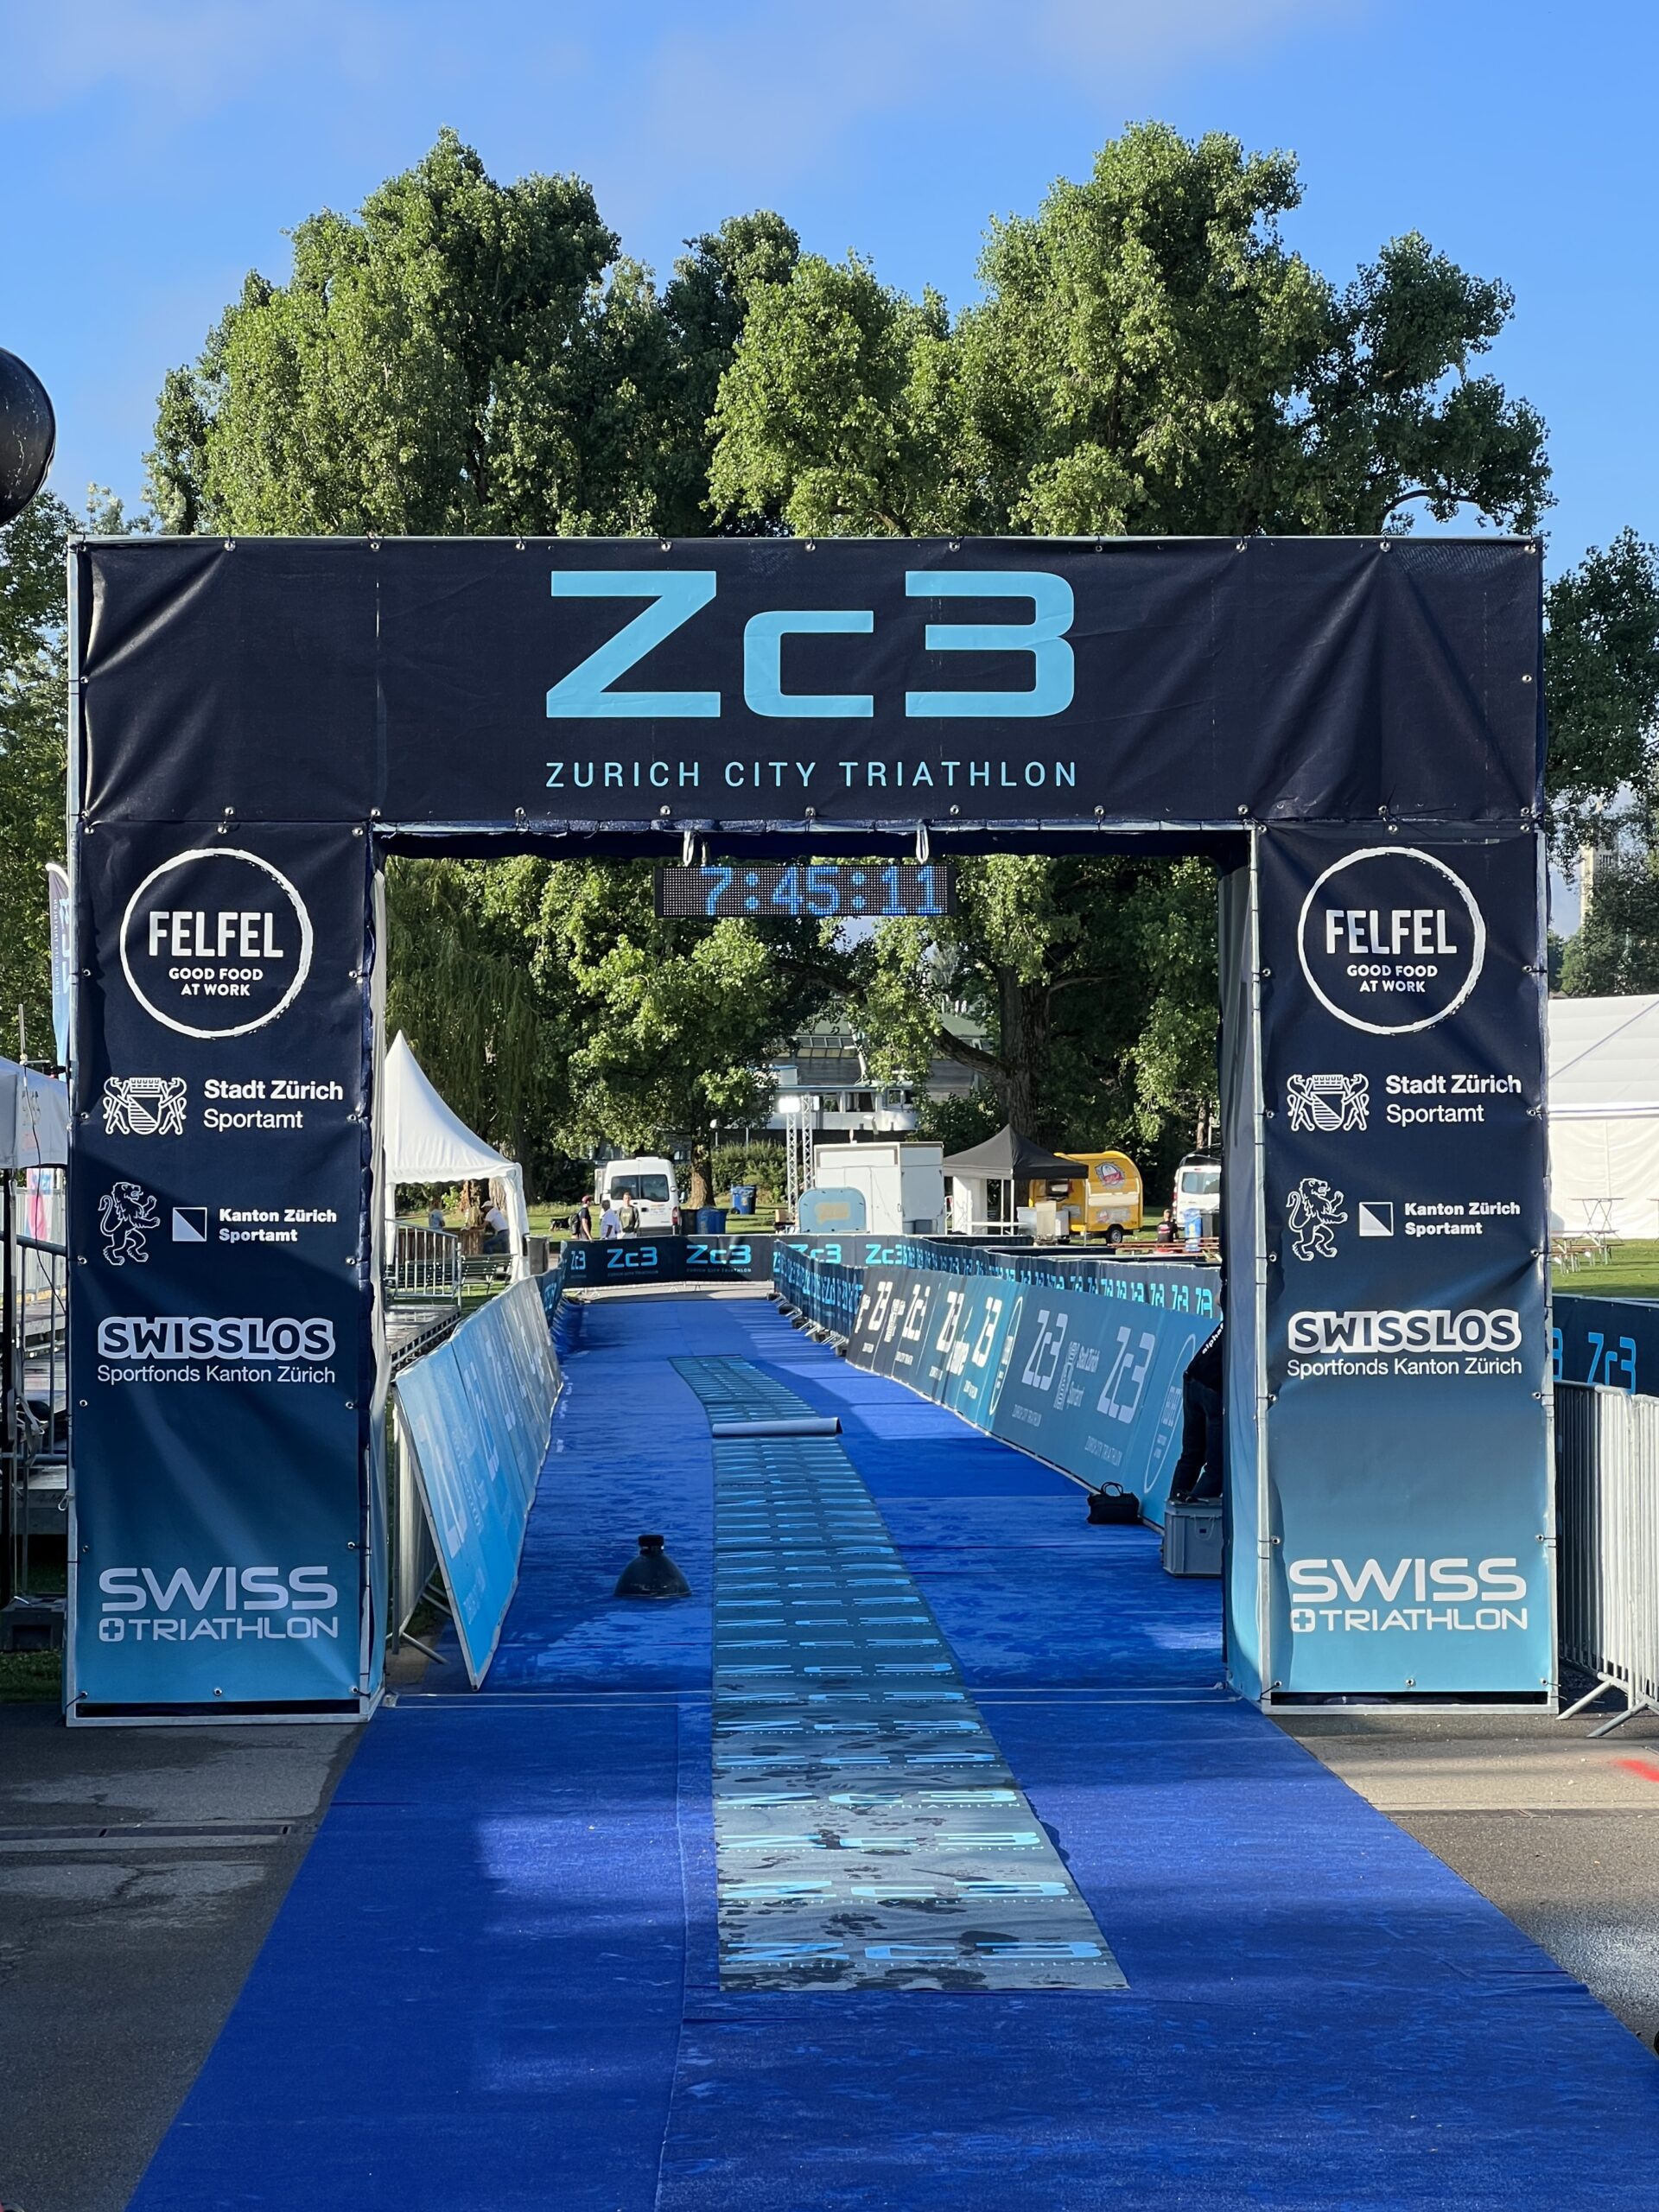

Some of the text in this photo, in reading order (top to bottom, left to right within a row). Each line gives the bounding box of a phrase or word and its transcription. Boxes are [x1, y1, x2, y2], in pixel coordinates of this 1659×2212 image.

[546, 570, 1076, 718] Zc3
[545, 761, 1077, 788] ZURICH CITY TRIATHLON
[700, 865, 943, 916] 7:45:11
[149, 911, 284, 957] FELFEL
[1325, 909, 1458, 955] FELFEL
[168, 968, 264, 981] GOOD FOOD
[1346, 964, 1438, 977] GOOD FOOD
[181, 983, 251, 996] AT WORK
[1359, 980, 1426, 993] AT WORK
[203, 1079, 343, 1100] Stadt Zürich
[1385, 1074, 1522, 1094] Stadt Zürich
[203, 1108, 303, 1132] Sportamt
[1386, 1103, 1484, 1127] Sportamt
[219, 1208, 336, 1223] Kanton Zürich
[1404, 1201, 1521, 1216] Kanton Zürich
[219, 1228, 297, 1243] Sportamt
[1404, 1221, 1483, 1237] Sportamt
[607, 1246, 658, 1268] Zc3
[686, 1244, 751, 1264] Zc3
[97, 1316, 336, 1361] SWISSLOS
[1288, 1309, 1522, 1354] SWISSLOS
[97, 1364, 335, 1385] Sportfonds Kanton Zürich
[1287, 1357, 1522, 1379] Sportfonds Kanton Zürich
[99, 1566, 338, 1611] SWISS
[1289, 1558, 1527, 1603] SWISS
[128, 1617, 338, 1640] TRIATHLON
[1319, 1608, 1528, 1631] TRIATHLON
[725, 1942, 1103, 1961] Zc3
